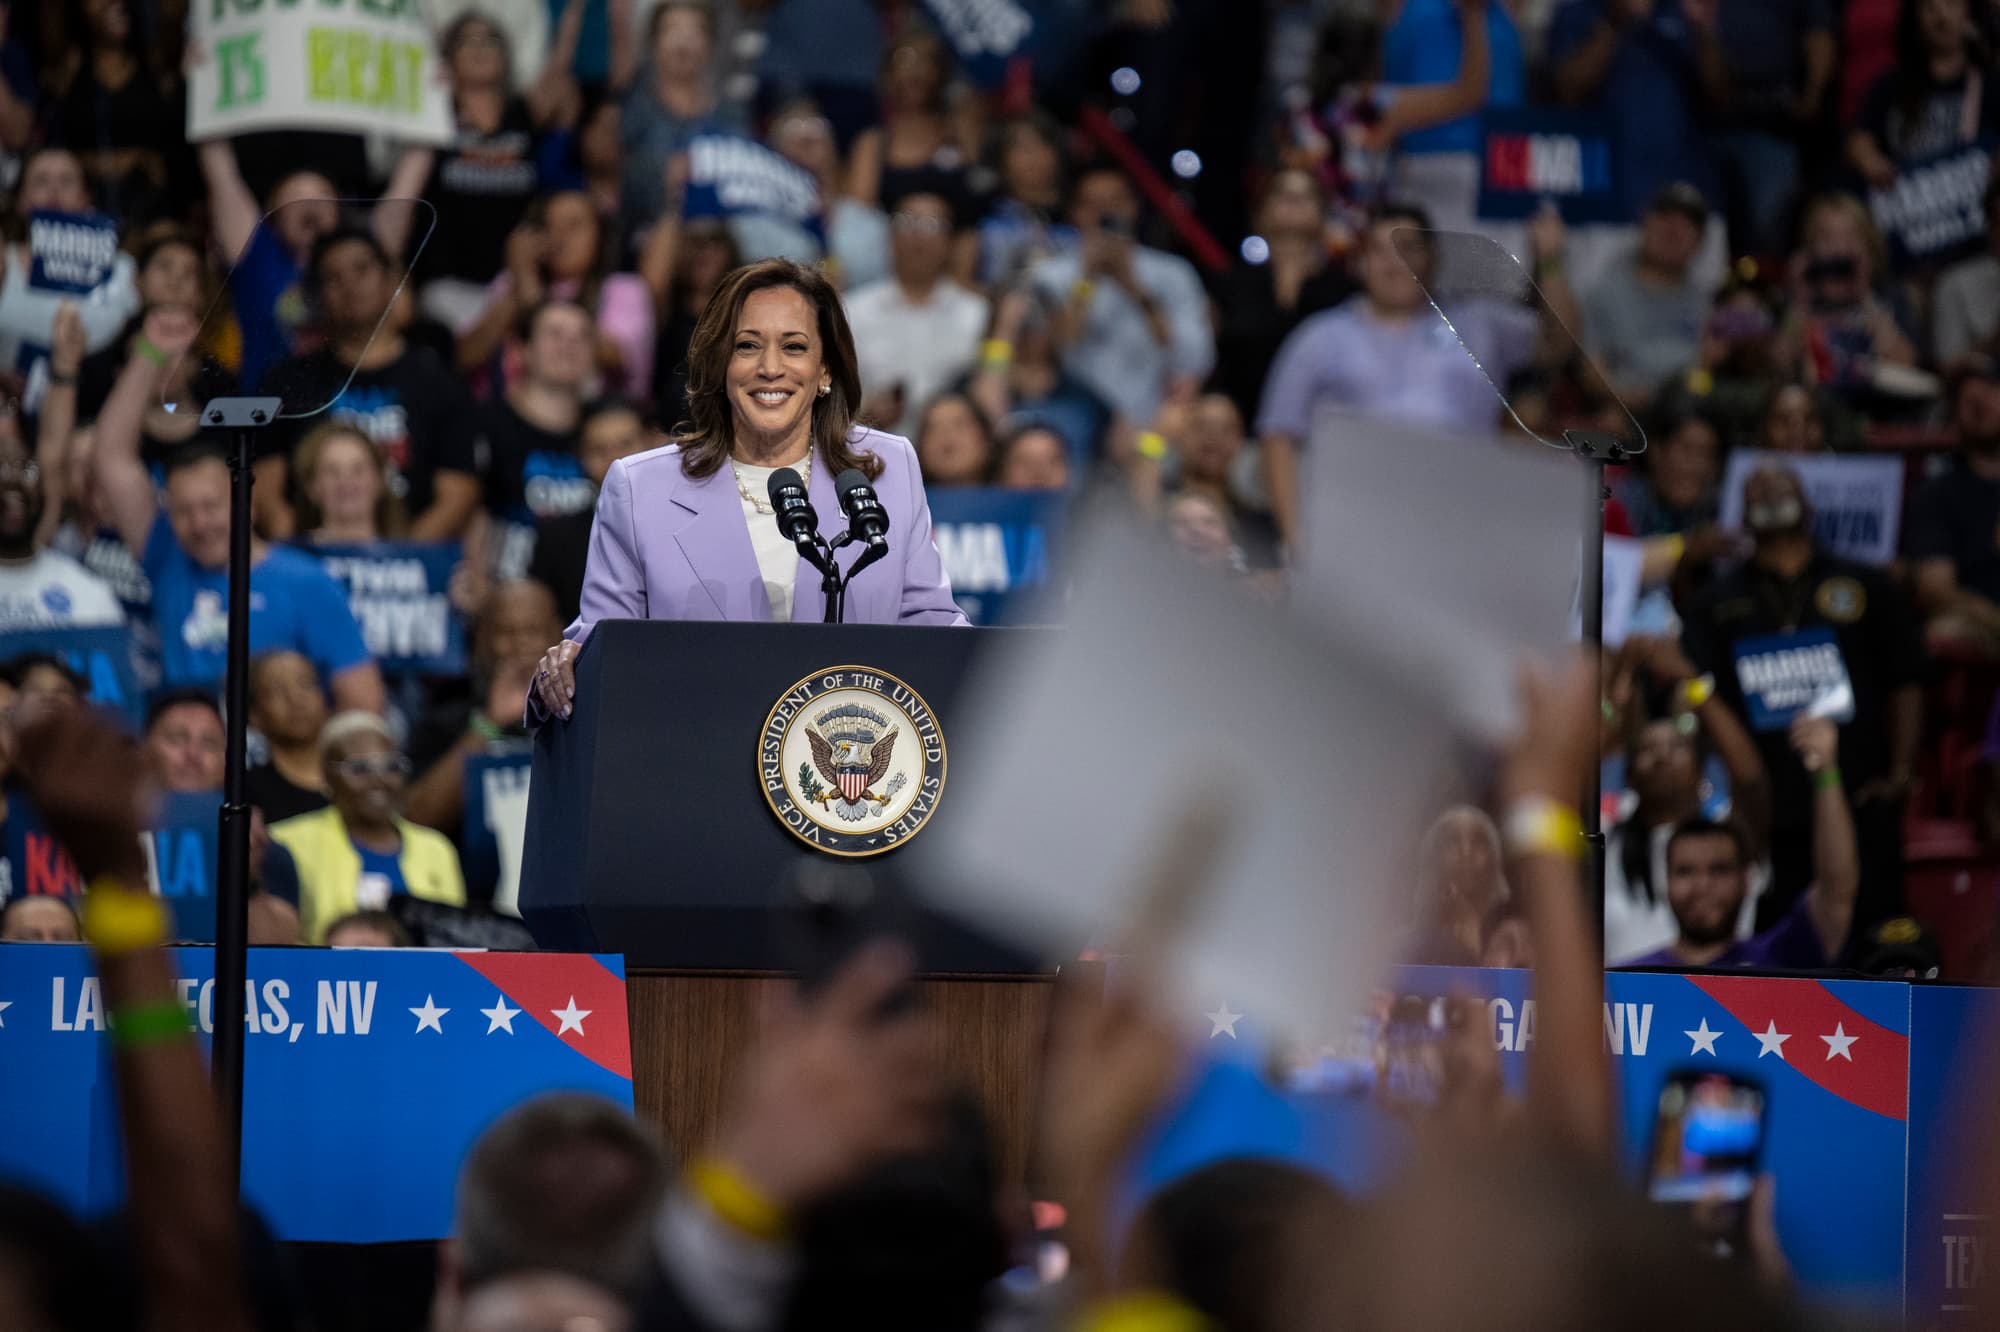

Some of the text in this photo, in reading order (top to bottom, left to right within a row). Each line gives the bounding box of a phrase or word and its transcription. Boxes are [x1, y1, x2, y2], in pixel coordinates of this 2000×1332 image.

[763, 673, 942, 844] VICE PRESIDENT OF THE UNITED STATES
[51, 976, 116, 1032] LA
[316, 980, 378, 1034] NV
[1602, 1002, 1654, 1056] NV
